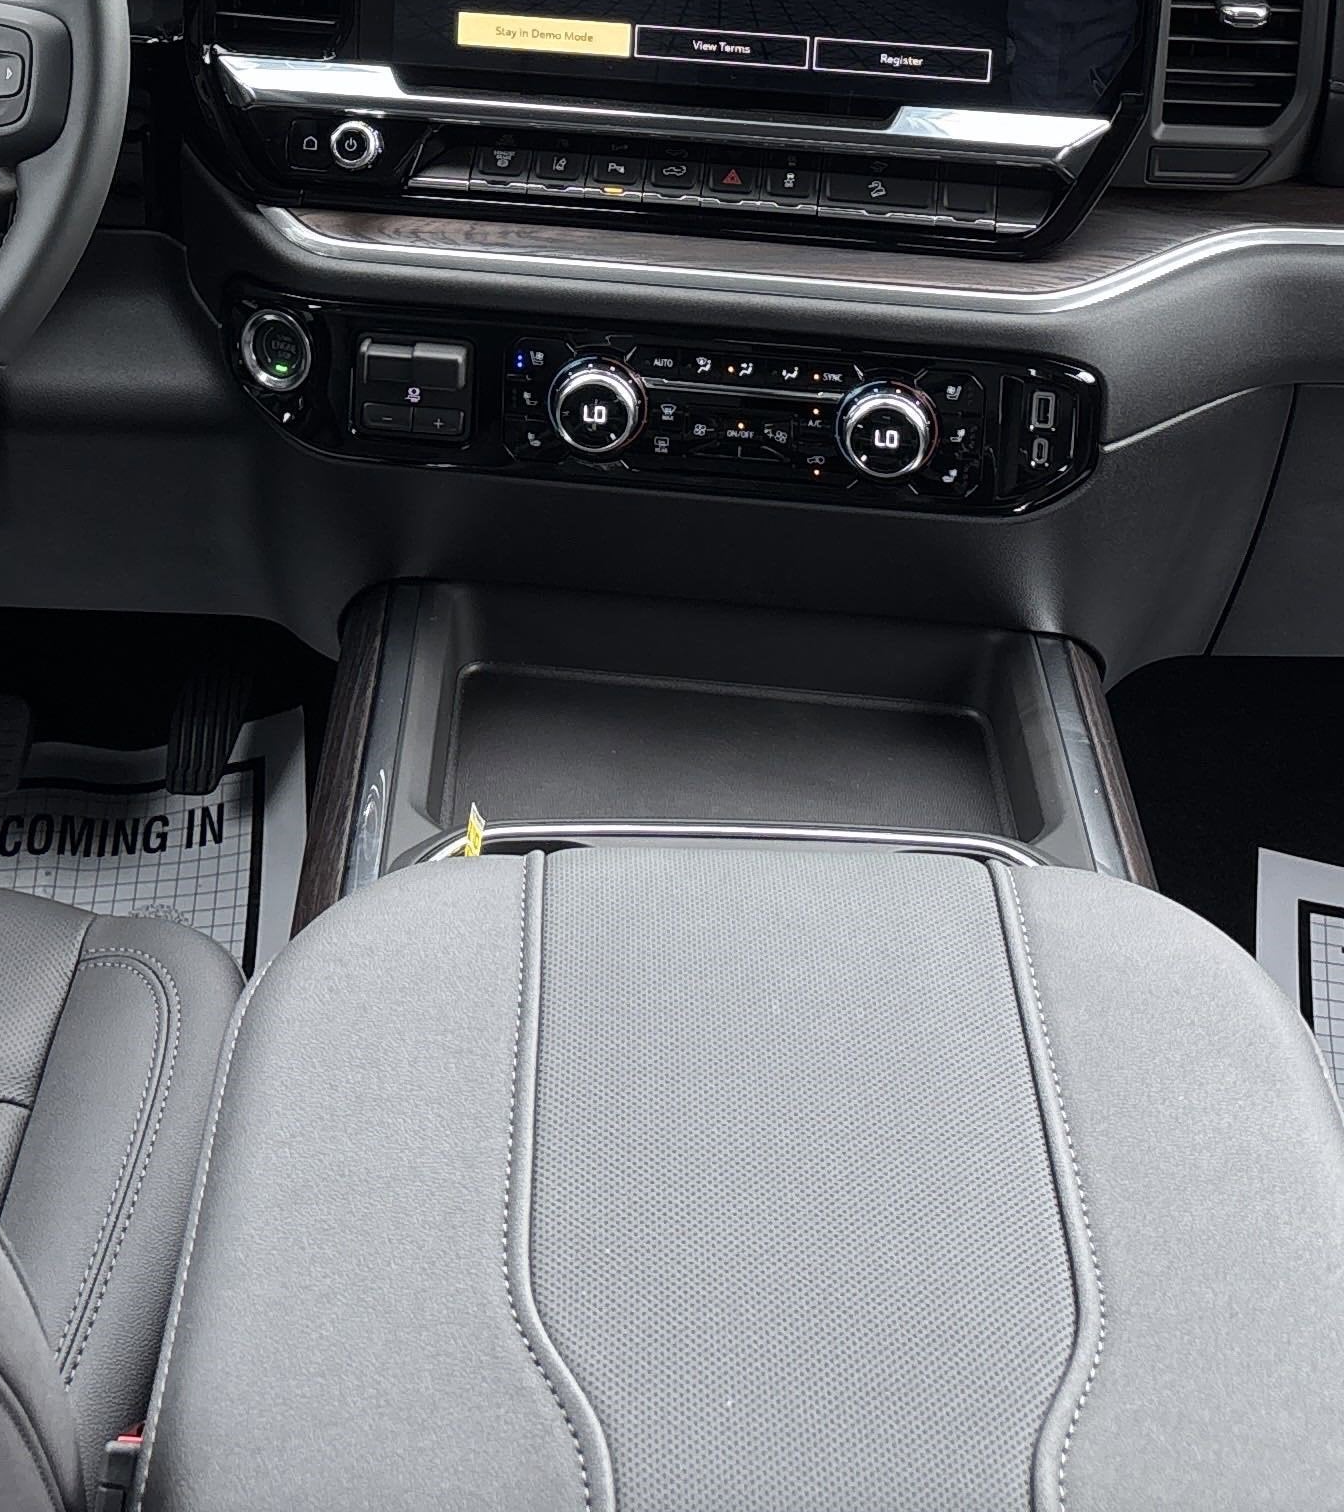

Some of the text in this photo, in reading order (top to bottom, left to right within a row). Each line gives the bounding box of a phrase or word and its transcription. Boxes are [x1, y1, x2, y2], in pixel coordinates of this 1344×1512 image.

[495, 26, 594, 43] Stay in Demo Mode
[692, 39, 751, 55] View Terms
[880, 53, 923, 69] Register
[654, 359, 673, 368] AUTO
[823, 373, 843, 382] SYNC
[583, 406, 606, 424] LO
[808, 420, 822, 428] A/C
[727, 430, 755, 439] ON/OFF
[875, 430, 899, 448] LO
[185, 802, 224, 849] IN
